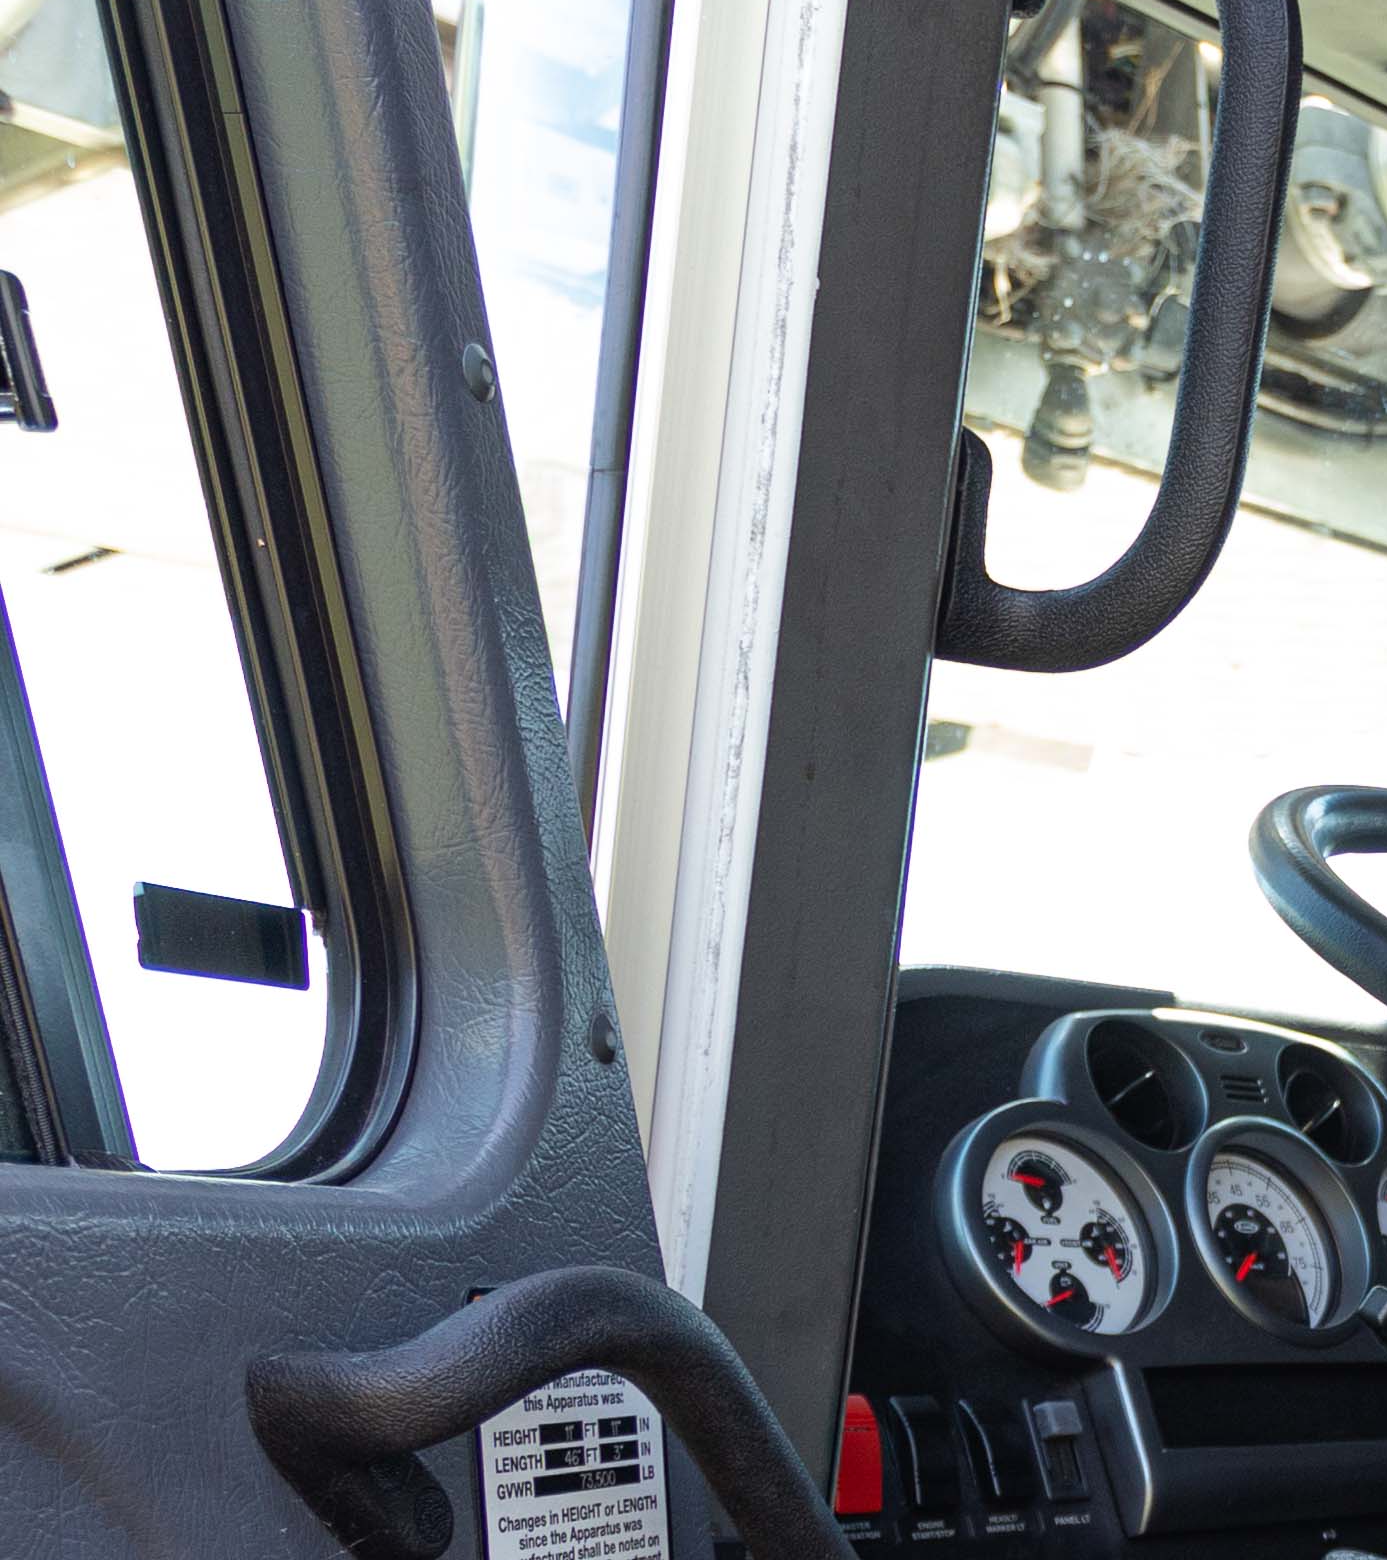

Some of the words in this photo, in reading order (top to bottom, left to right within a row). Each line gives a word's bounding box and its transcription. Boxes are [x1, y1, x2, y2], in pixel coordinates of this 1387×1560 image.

[523, 1396, 543, 1411] this
[546, 1394, 599, 1413] Apparatus
[601, 1392, 624, 1404] was:
[493, 1428, 538, 1448] HEIGHT
[584, 1422, 597, 1438] FT
[639, 1417, 650, 1432] IN
[495, 1454, 543, 1474] LENGTH
[585, 1447, 598, 1463] FT
[641, 1441, 652, 1456] IN
[497, 1481, 533, 1500] GVWR
[642, 1465, 655, 1481] LB
[498, 1517, 547, 1534] Changes
[549, 1511, 559, 1525] in
[561, 1503, 602, 1523] HEIGHT
[604, 1504, 615, 1516] or
[617, 1495, 657, 1514] LENGTH
[519, 1536, 547, 1551] since
[550, 1531, 567, 1545] the
[570, 1522, 621, 1544] Apparatus
[623, 1519, 642, 1532] was
[578, 1543, 601, 1559] shall
[603, 1541, 616, 1555] be
[618, 1537, 646, 1552] noted
[648, 1534, 660, 1547] on
